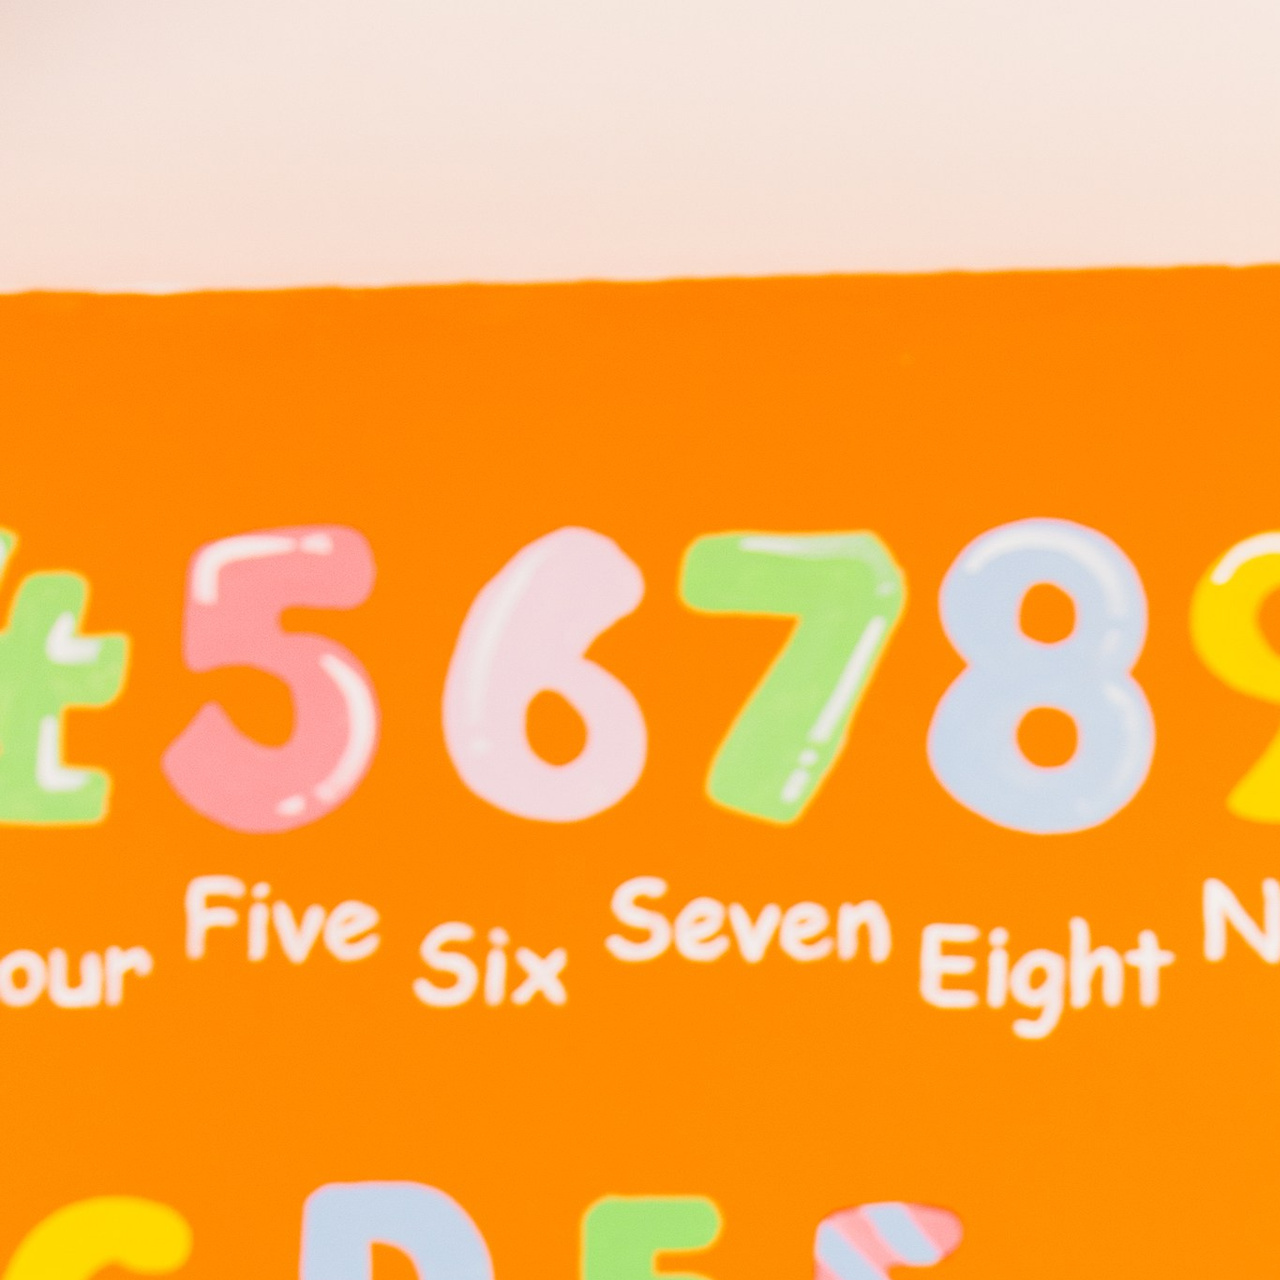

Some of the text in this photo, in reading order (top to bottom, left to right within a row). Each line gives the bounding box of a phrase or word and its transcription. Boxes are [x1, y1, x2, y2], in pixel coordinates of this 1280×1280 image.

[161, 525, 381, 834] 5
[441, 526, 649, 824] 6
[678, 530, 907, 825] 7
[925, 517, 1157, 836] 8
[0, 945, 154, 1009] our
[184, 873, 381, 964] Five
[412, 921, 568, 1008] Six
[605, 875, 893, 964] Seven
[919, 916, 1176, 1040] Eight
